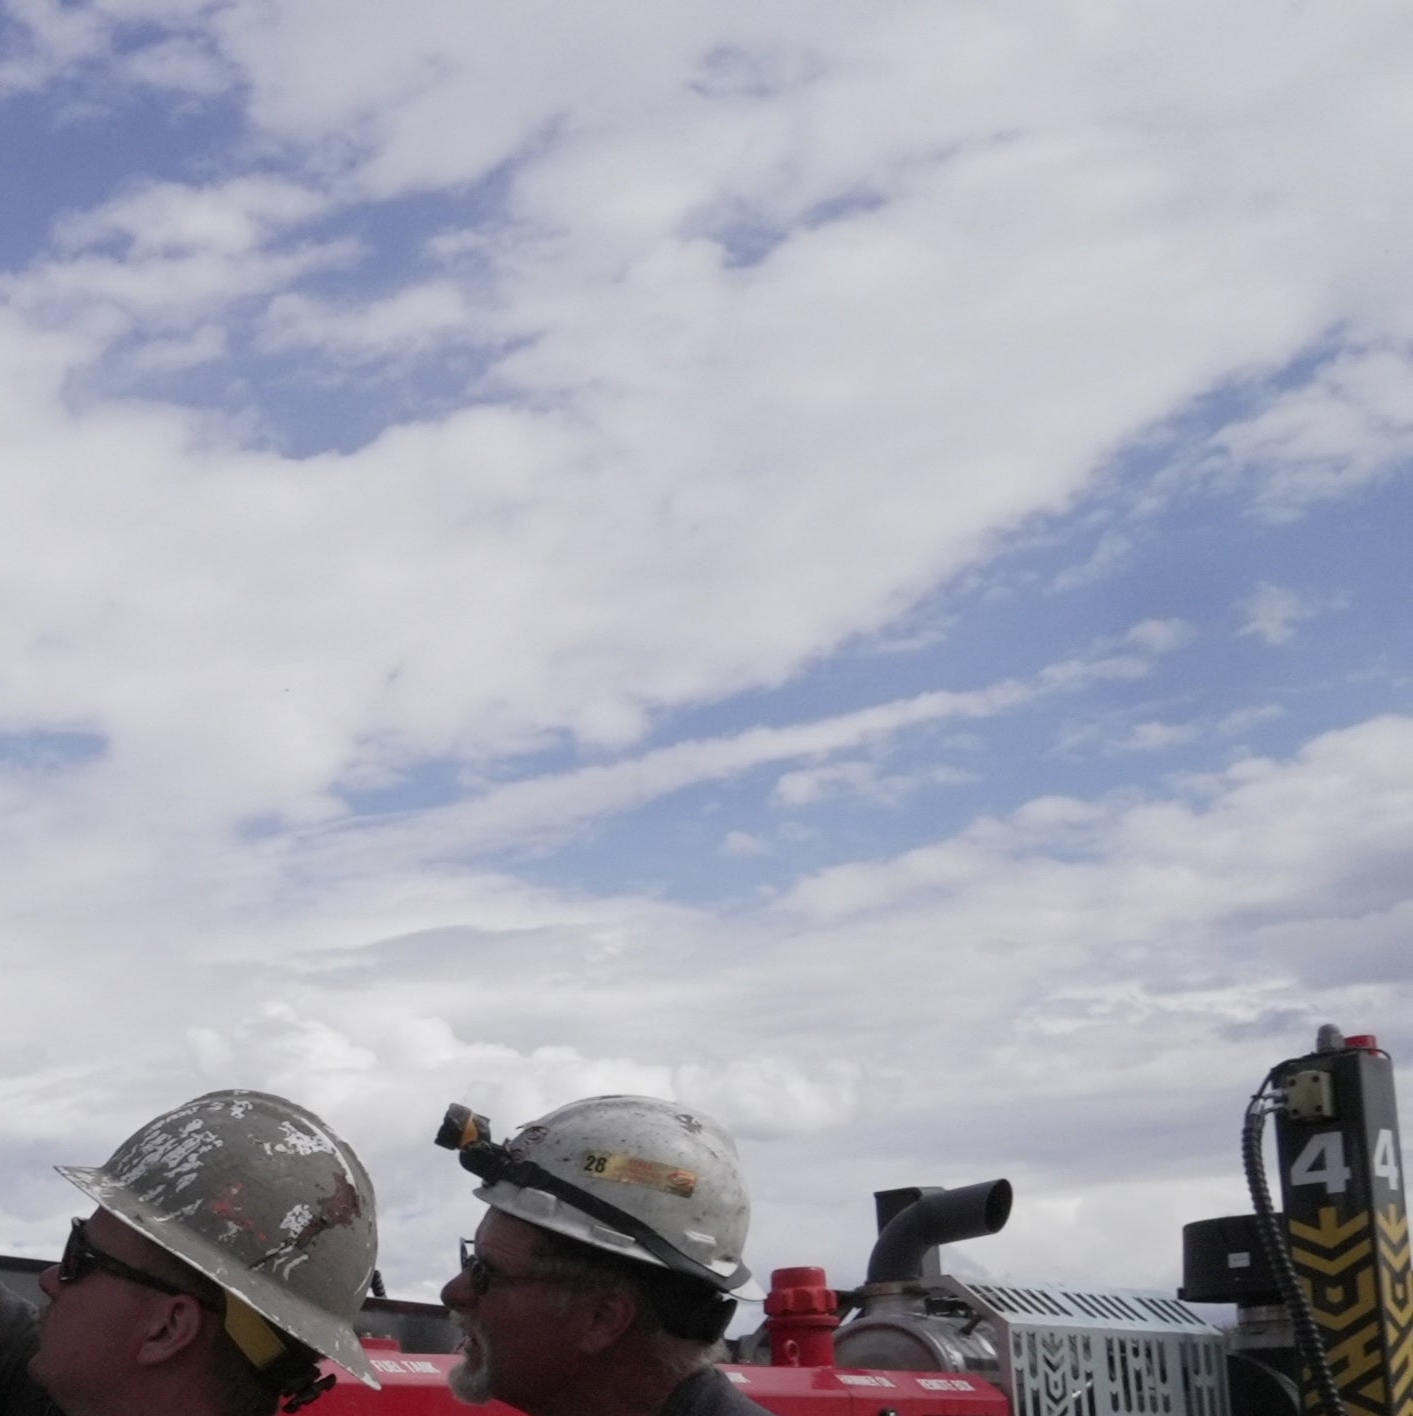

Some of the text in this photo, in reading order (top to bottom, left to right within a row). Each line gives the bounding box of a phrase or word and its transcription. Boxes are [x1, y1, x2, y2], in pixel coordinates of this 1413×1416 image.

[584, 1155, 607, 1173] 28
[1290, 1131, 1351, 1194] 4
[1373, 1128, 1399, 1191] 4
[370, 1359, 407, 1373] FUEL
